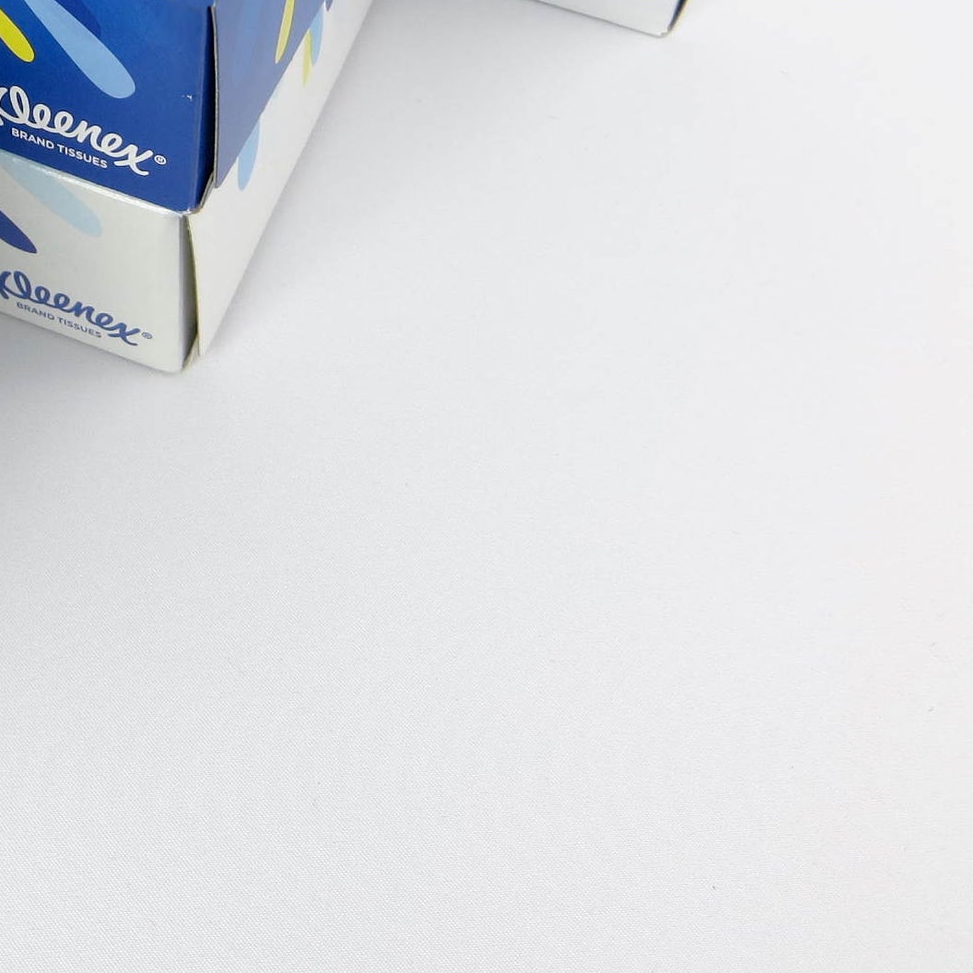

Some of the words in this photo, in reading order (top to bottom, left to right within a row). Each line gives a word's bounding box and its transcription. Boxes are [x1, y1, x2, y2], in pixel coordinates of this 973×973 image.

[11, 127, 55, 150] BRAND
[57, 143, 108, 169] TISSUES
[16, 301, 55, 321] BRAND
[57, 318, 102, 339] TISSUES
